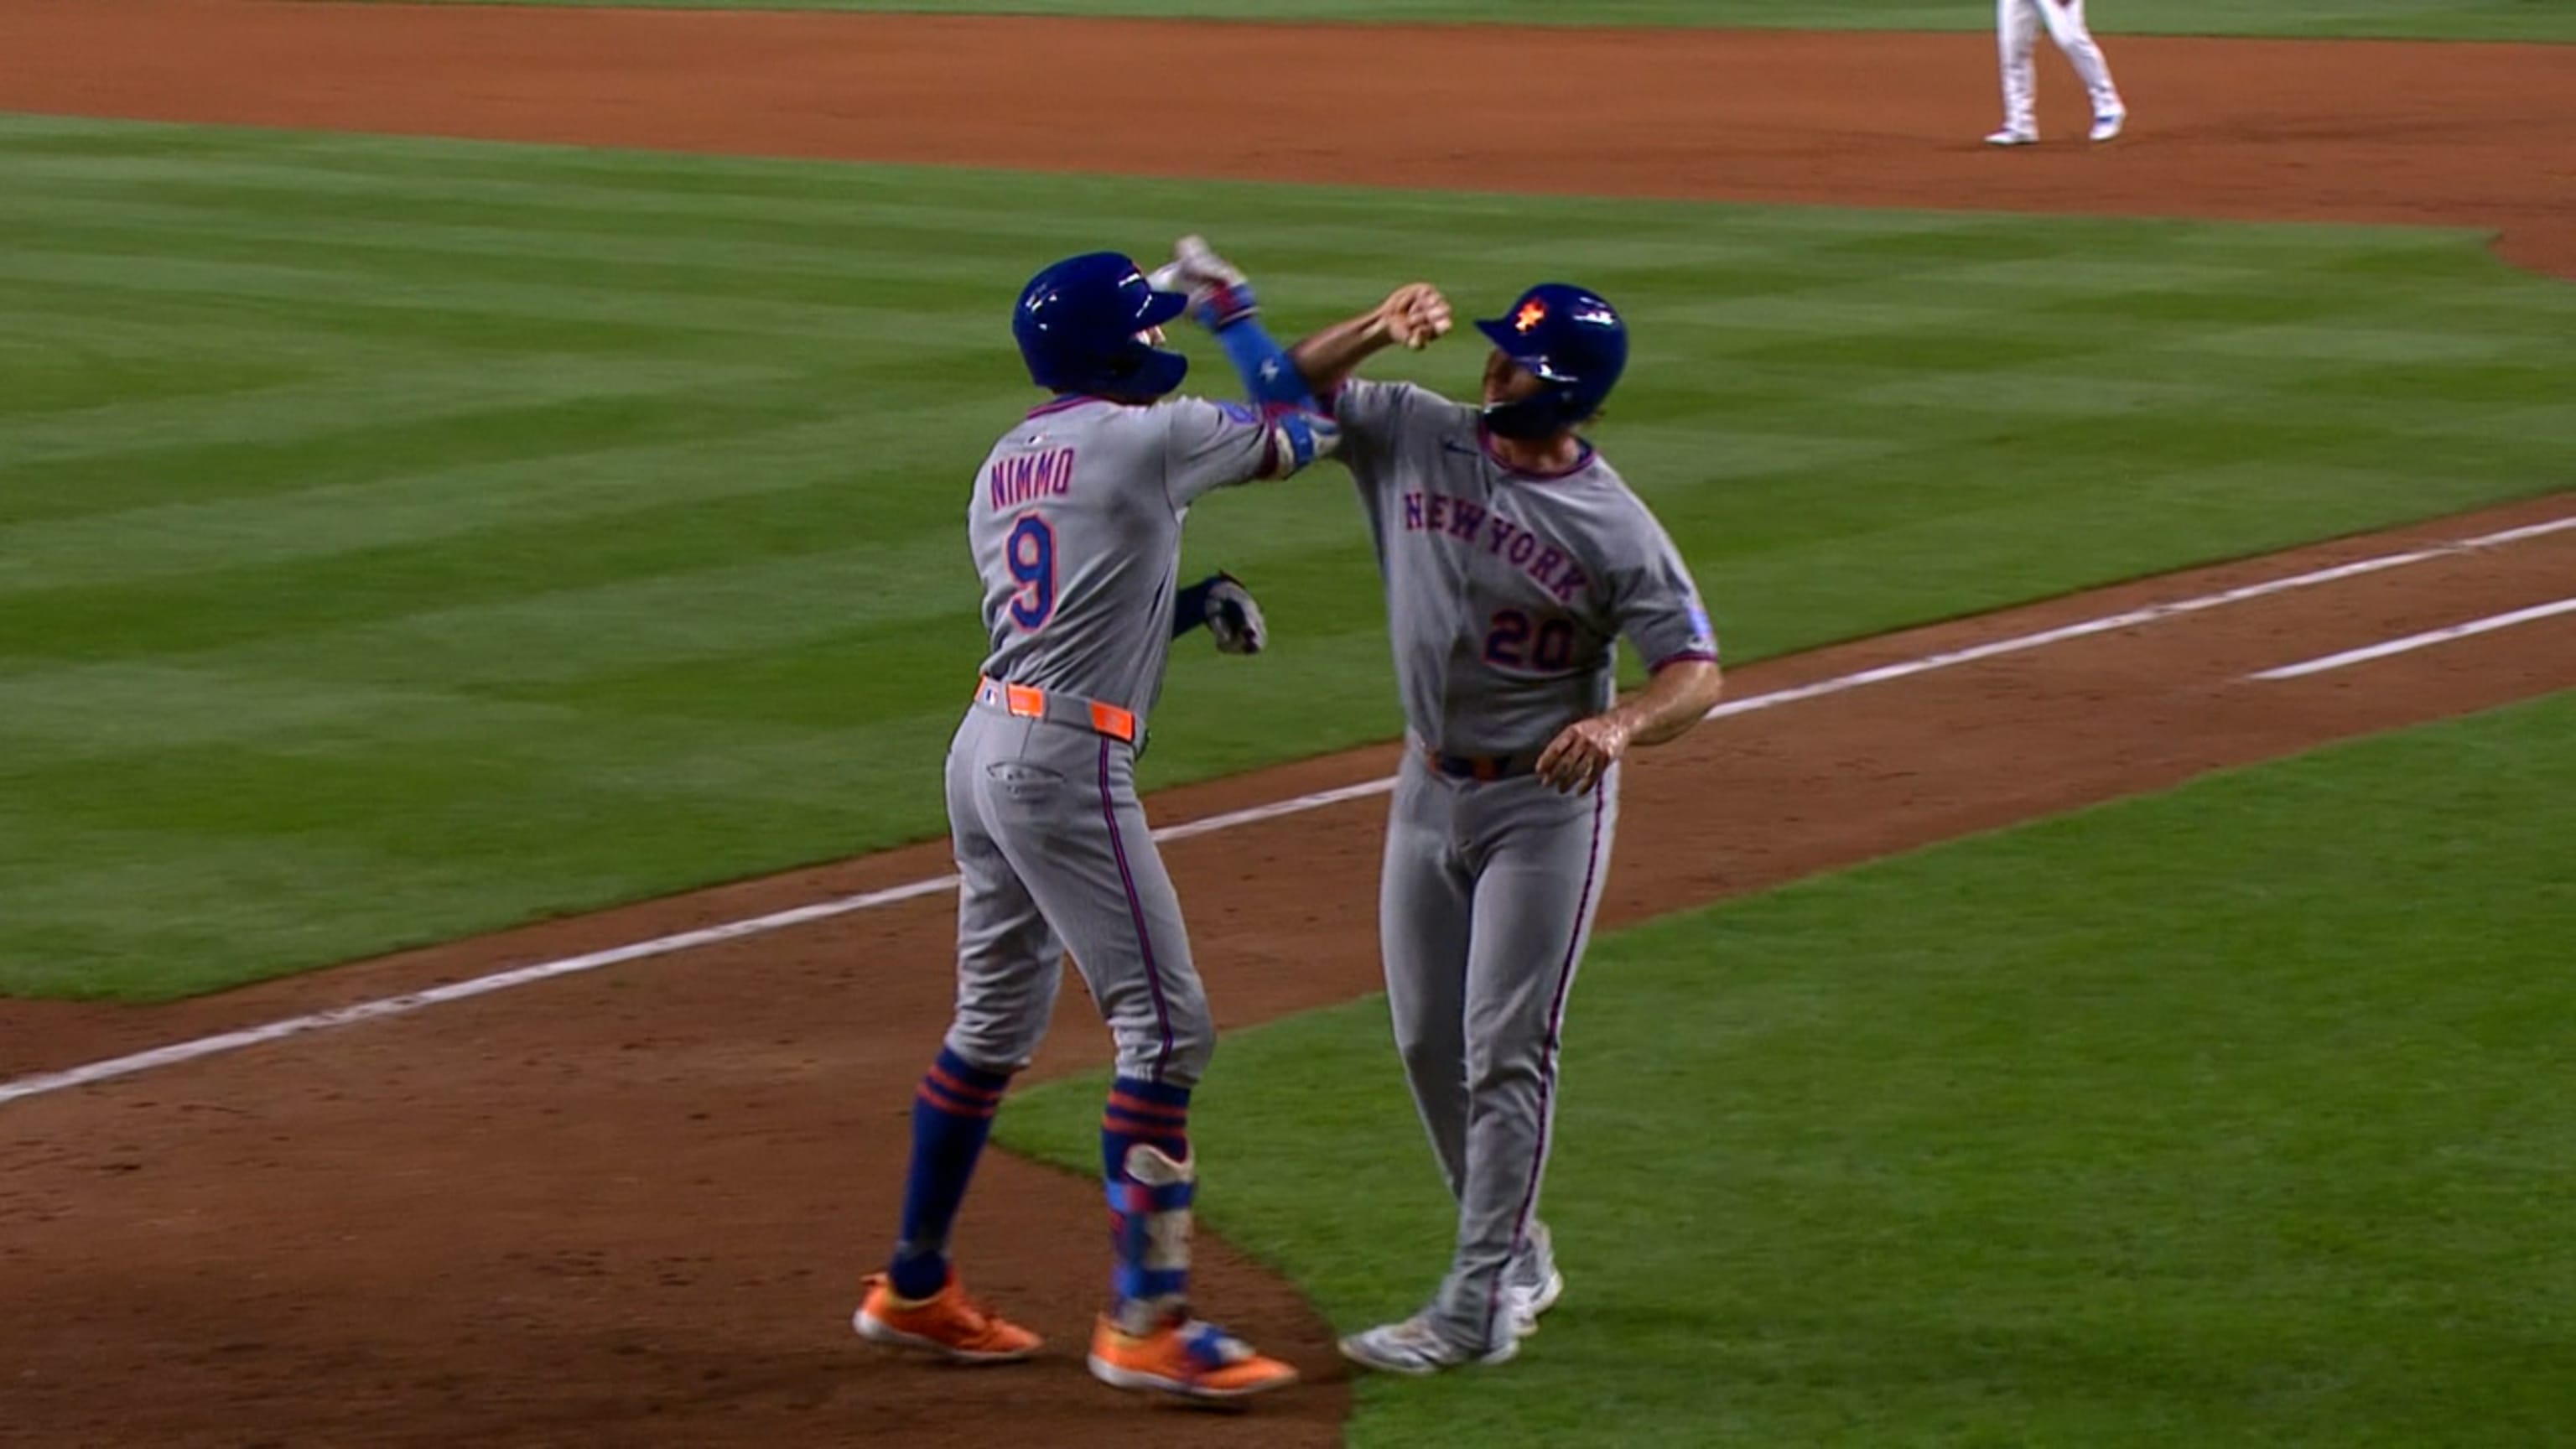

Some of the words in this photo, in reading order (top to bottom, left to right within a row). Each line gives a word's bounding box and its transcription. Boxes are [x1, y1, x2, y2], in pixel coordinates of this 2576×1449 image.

[990, 448, 1074, 512] NIMMO
[1005, 512, 1057, 633] 9
[1404, 492, 1488, 543] NEW
[1487, 517, 1587, 605] YORK
[1483, 609, 1576, 671] 20
